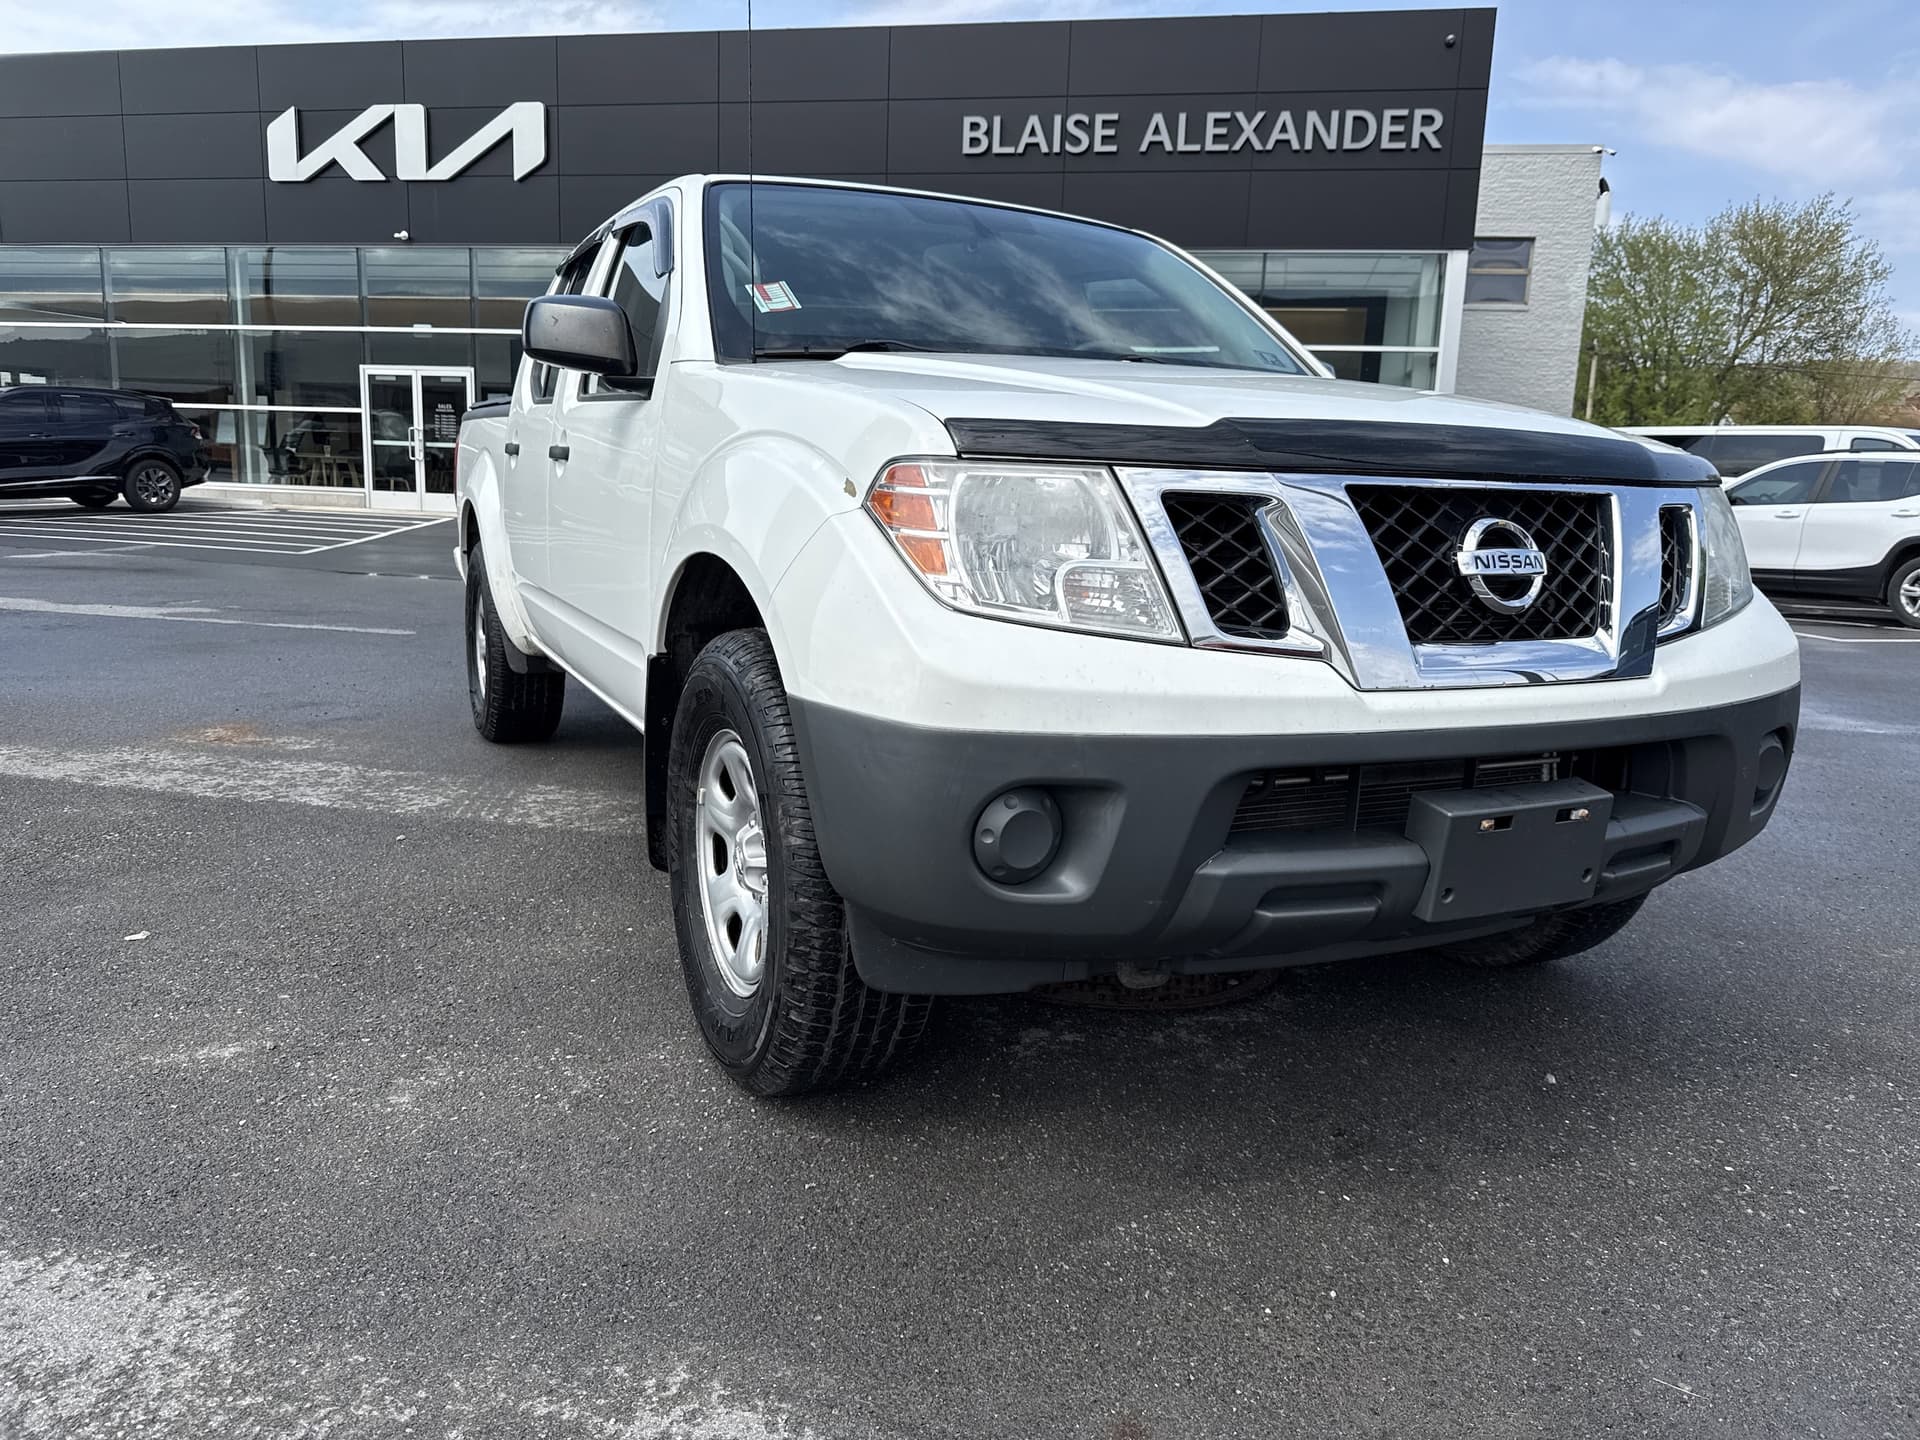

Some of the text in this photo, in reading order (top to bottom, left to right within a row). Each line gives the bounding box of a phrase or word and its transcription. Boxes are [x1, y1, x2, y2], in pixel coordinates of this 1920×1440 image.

[266, 101, 547, 182] KIA
[961, 107, 1445, 155] BLAISE ALEXANDER
[1473, 554, 1544, 570] NISSAN
